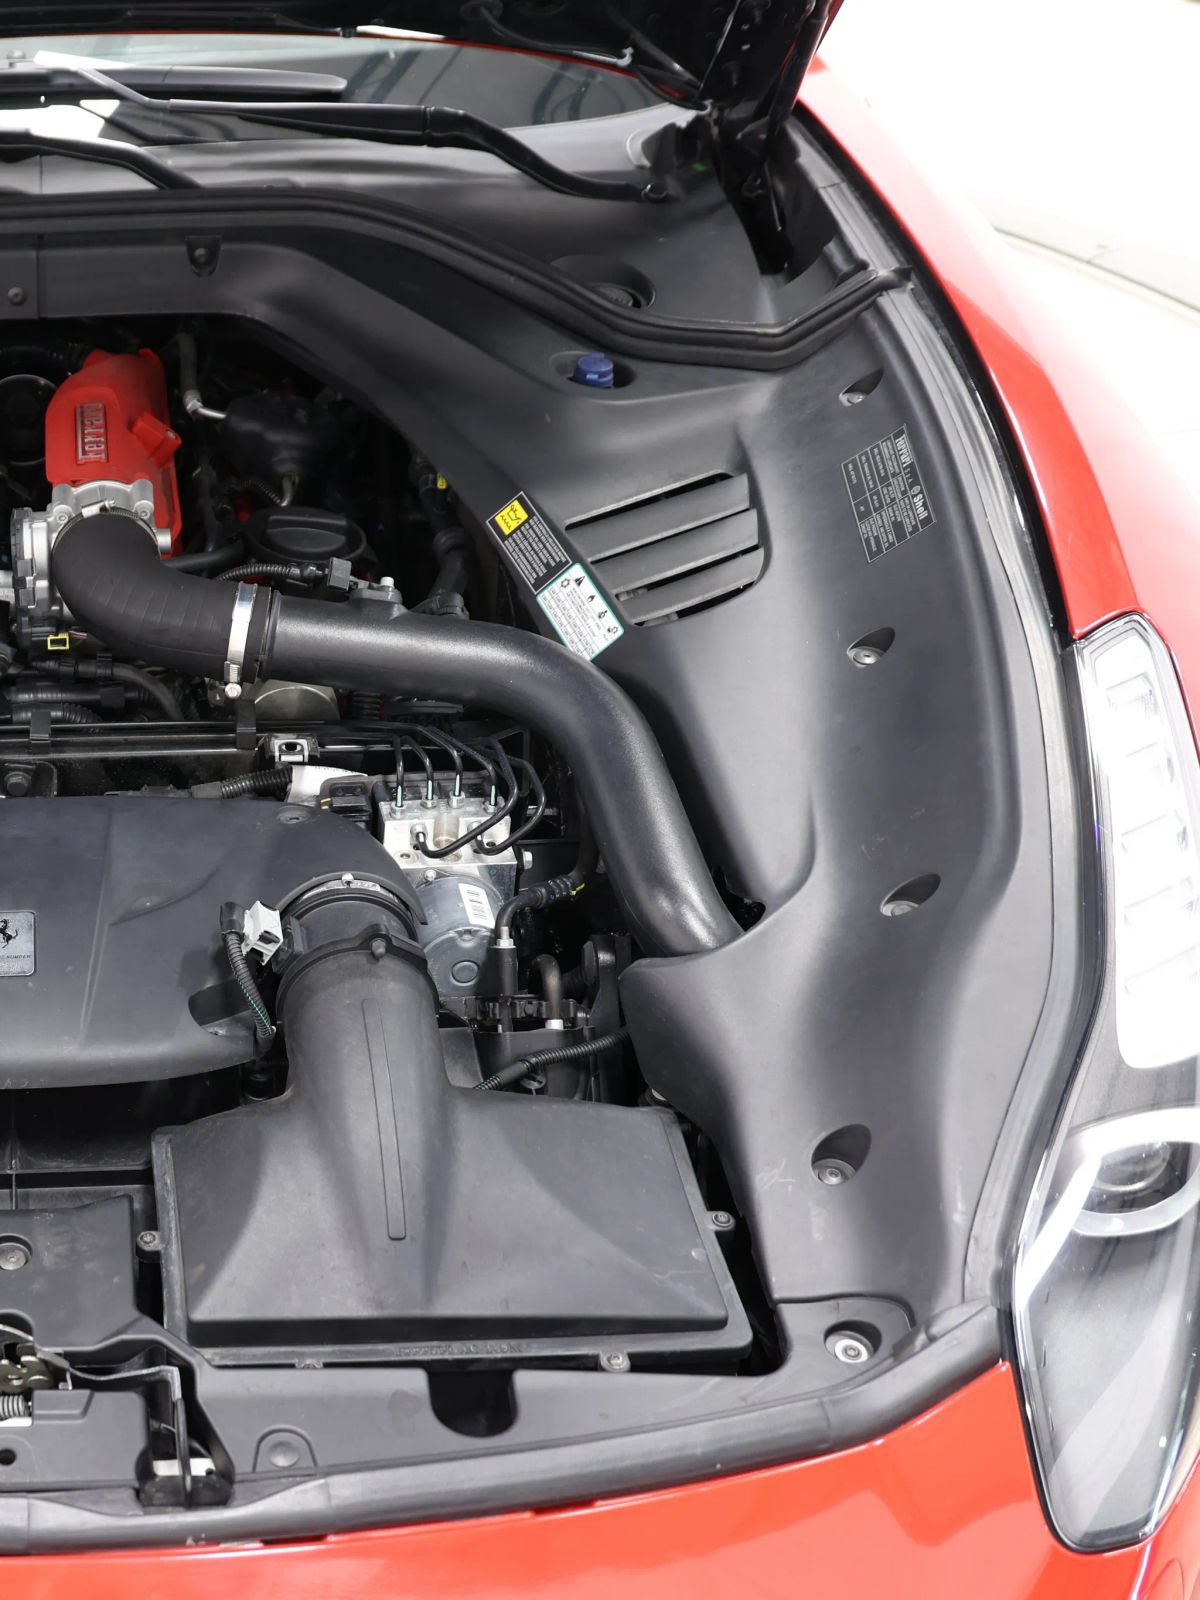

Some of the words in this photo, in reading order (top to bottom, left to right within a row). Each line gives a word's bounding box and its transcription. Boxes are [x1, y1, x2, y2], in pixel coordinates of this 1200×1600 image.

[76, 402, 106, 460] Ferrari
[894, 434, 914, 467] Ferrari
[913, 494, 929, 520] Shell
